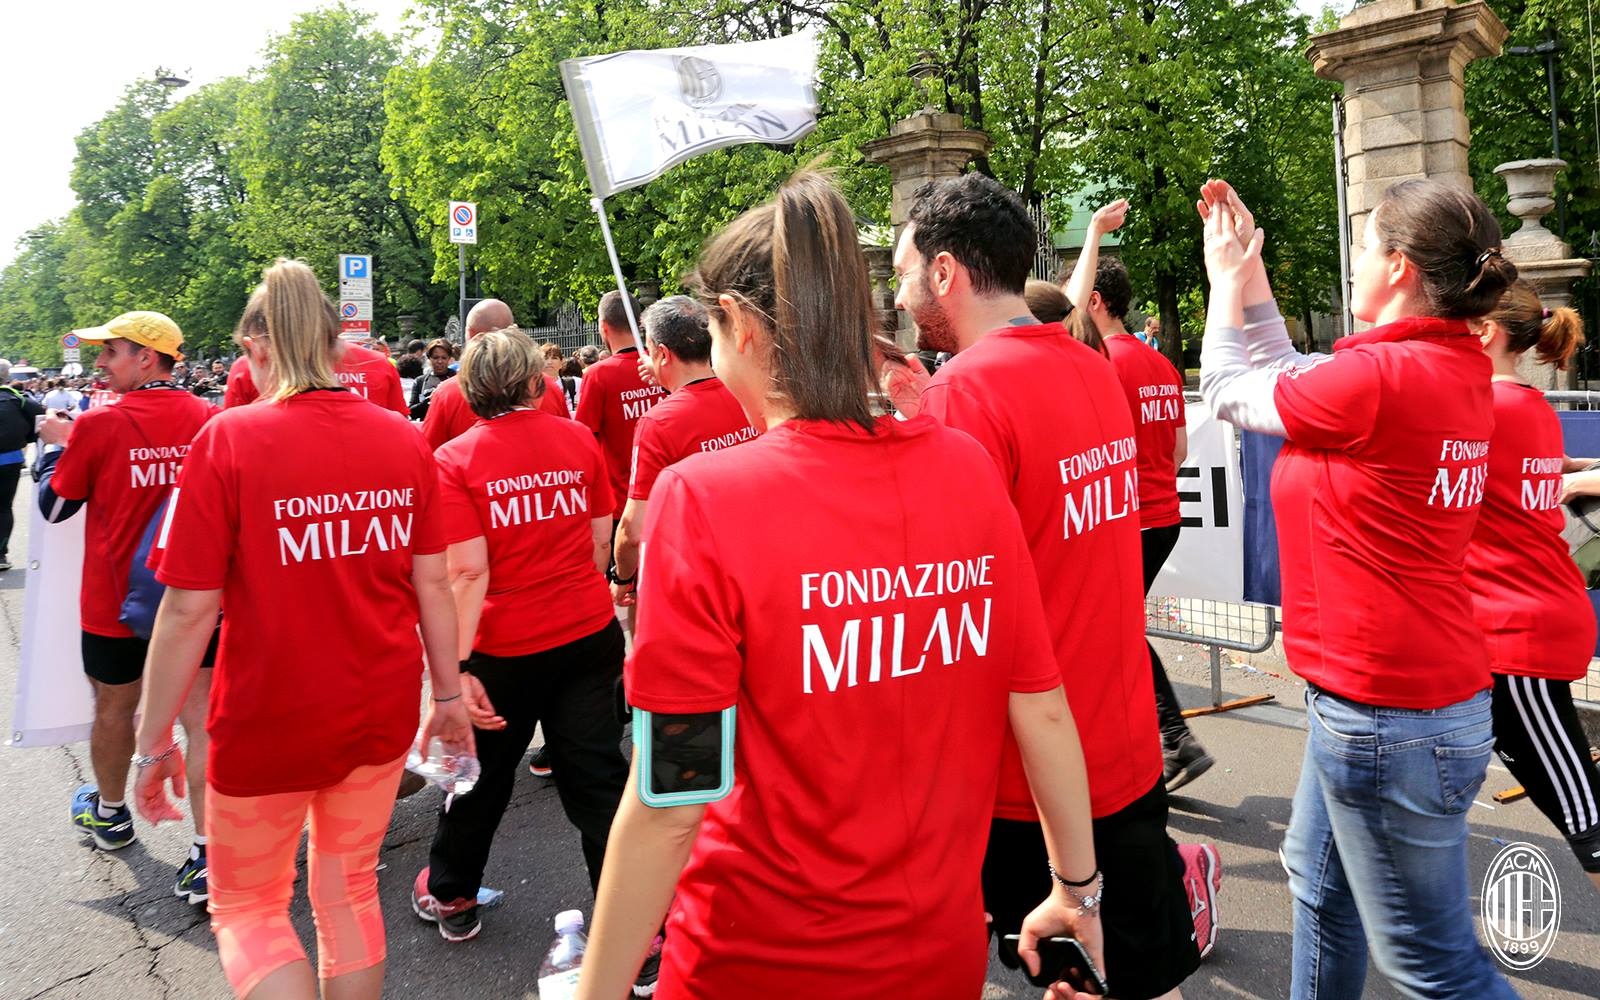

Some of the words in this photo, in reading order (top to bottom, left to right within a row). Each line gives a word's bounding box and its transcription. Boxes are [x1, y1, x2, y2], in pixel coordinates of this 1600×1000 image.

[273, 488, 414, 520] FONDAZIONE
[486, 470, 584, 497] FONDAZIONE
[489, 486, 588, 529] MILAN
[276, 513, 414, 566] MILAN
[801, 554, 994, 610] FONDAZIONE
[801, 597, 992, 694] MILAN
